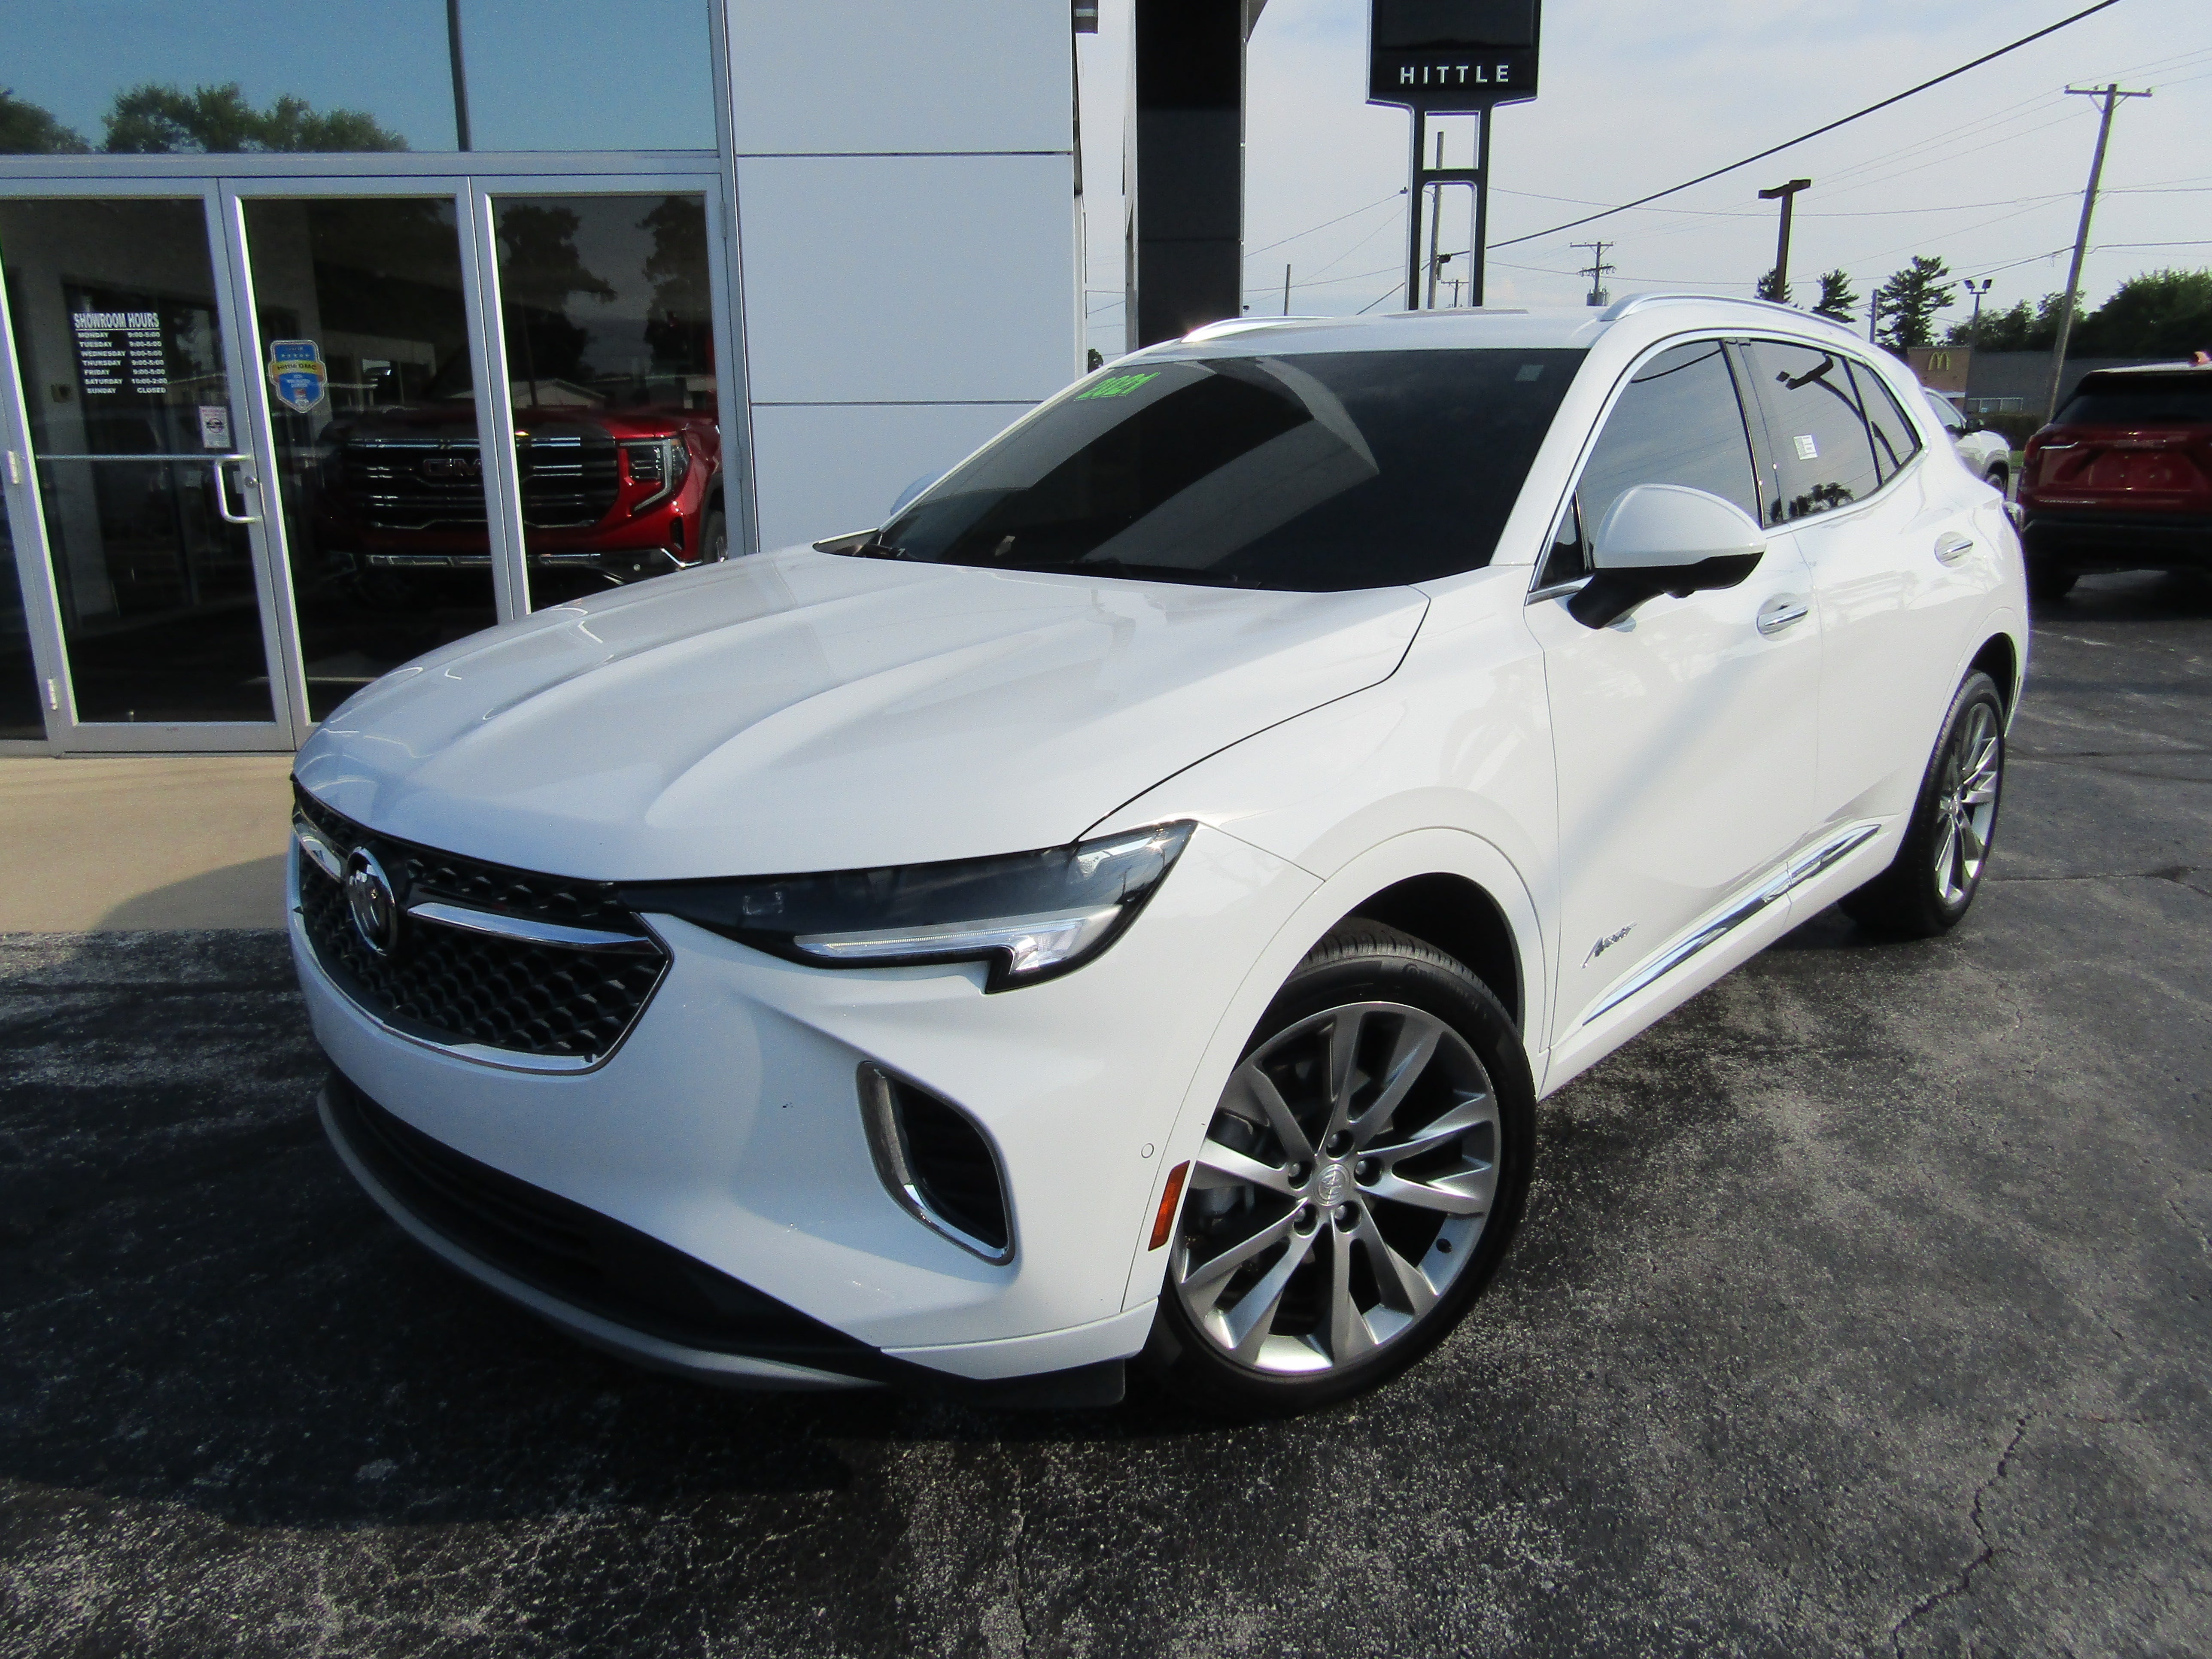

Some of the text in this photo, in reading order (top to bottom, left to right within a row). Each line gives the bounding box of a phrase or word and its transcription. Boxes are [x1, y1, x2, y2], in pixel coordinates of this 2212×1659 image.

[1400, 65, 1509, 84] HITTLE
[73, 312, 160, 328] SHOWROOM HOURS
[423, 459, 481, 476] GM
